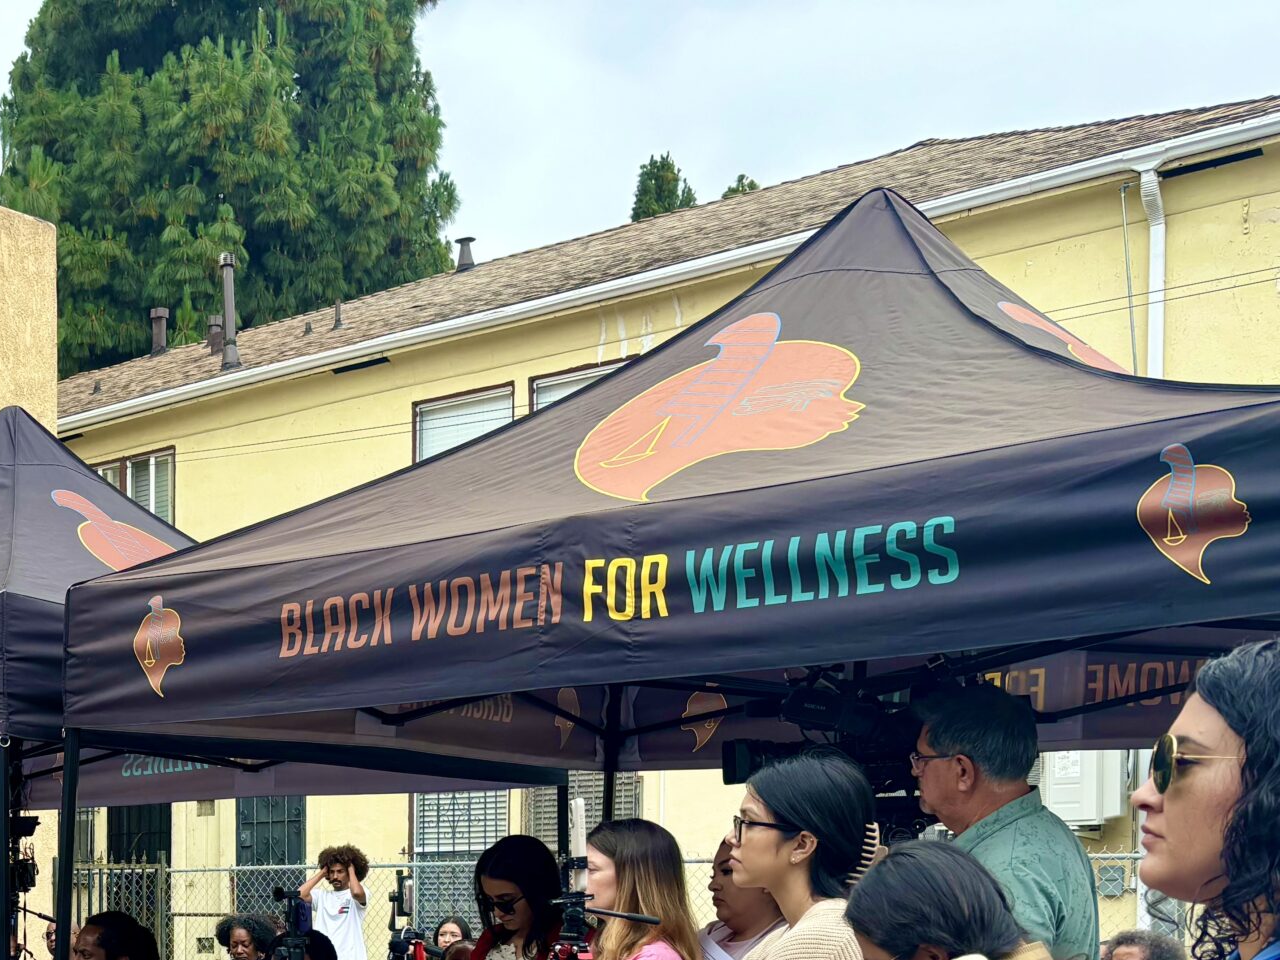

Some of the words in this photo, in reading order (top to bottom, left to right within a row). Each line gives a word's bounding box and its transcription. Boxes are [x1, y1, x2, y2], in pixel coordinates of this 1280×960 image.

[279, 588, 396, 658] BLACK
[409, 562, 564, 641] WOMEN
[583, 554, 668, 622] FOR
[686, 516, 960, 614] WELLNESS
